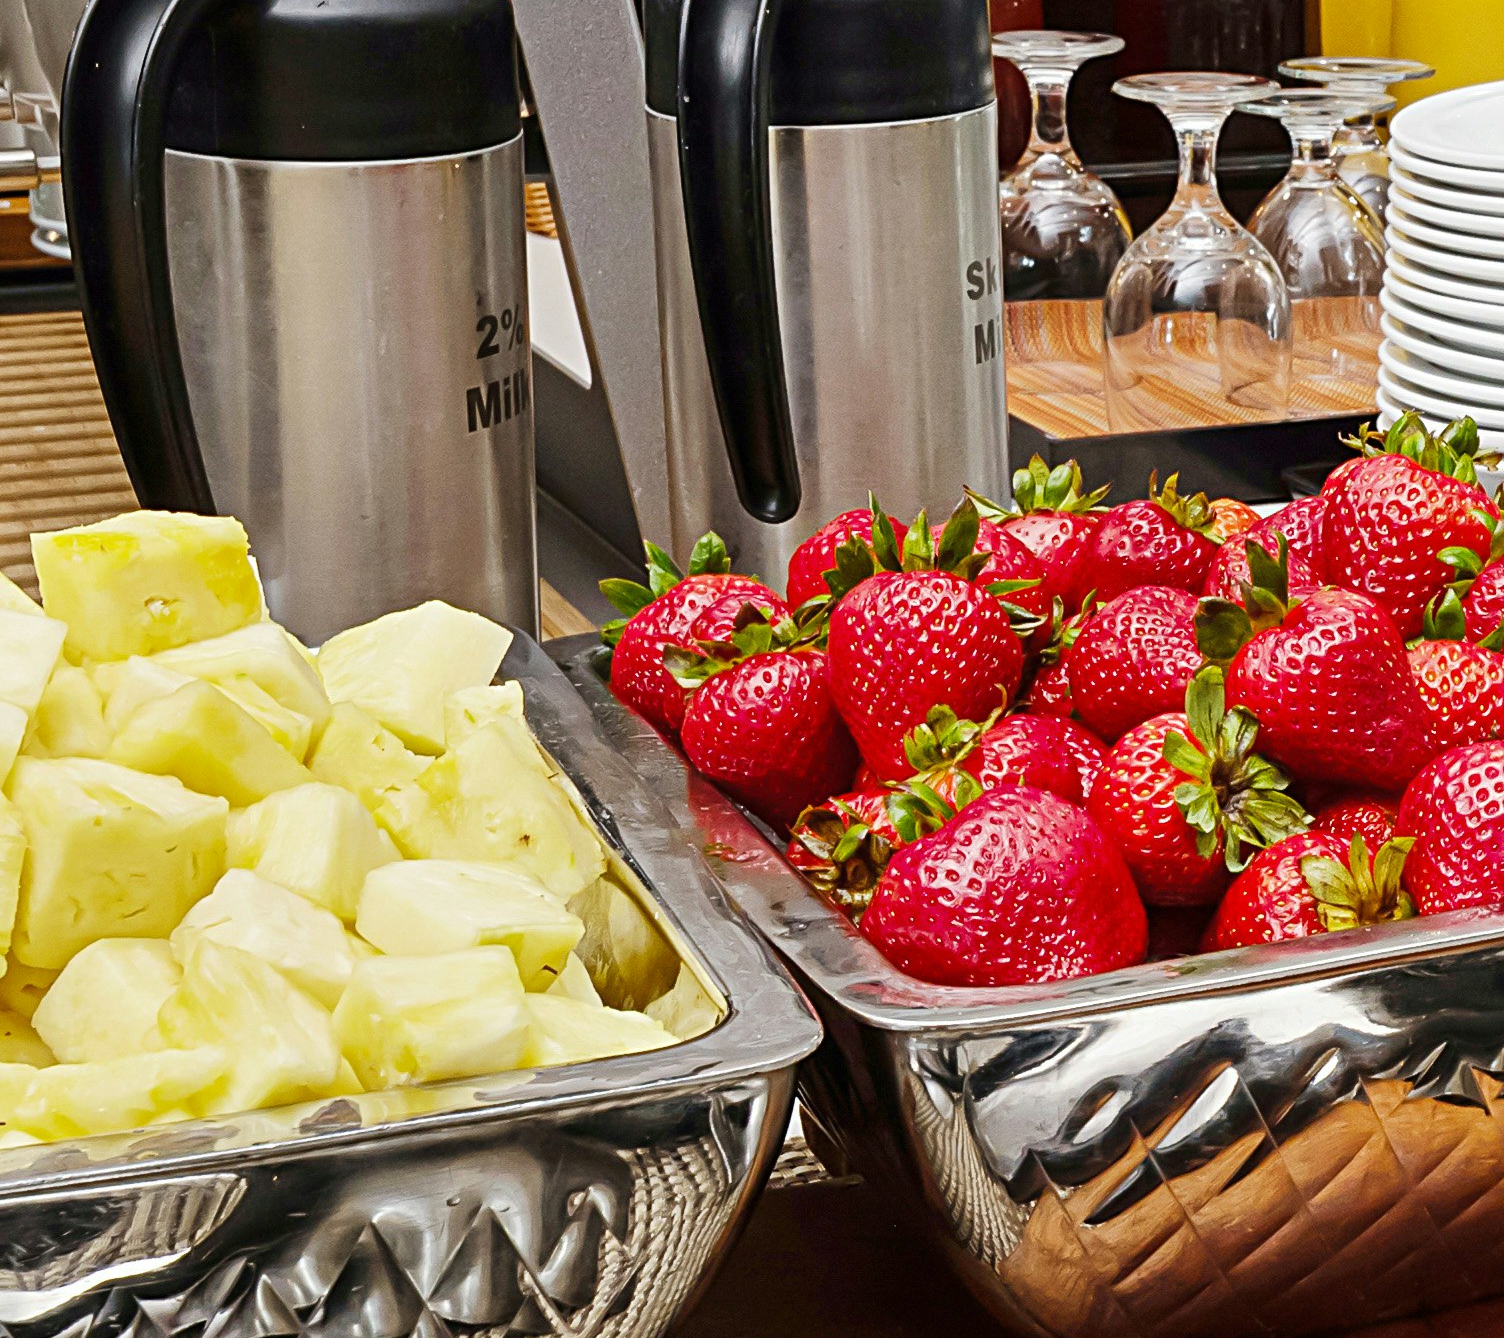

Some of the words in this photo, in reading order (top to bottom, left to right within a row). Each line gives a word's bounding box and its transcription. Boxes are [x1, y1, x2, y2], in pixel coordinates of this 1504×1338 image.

[967, 257, 997, 300] Sk
[476, 304, 524, 360] 2%
[975, 315, 1001, 365] Mi
